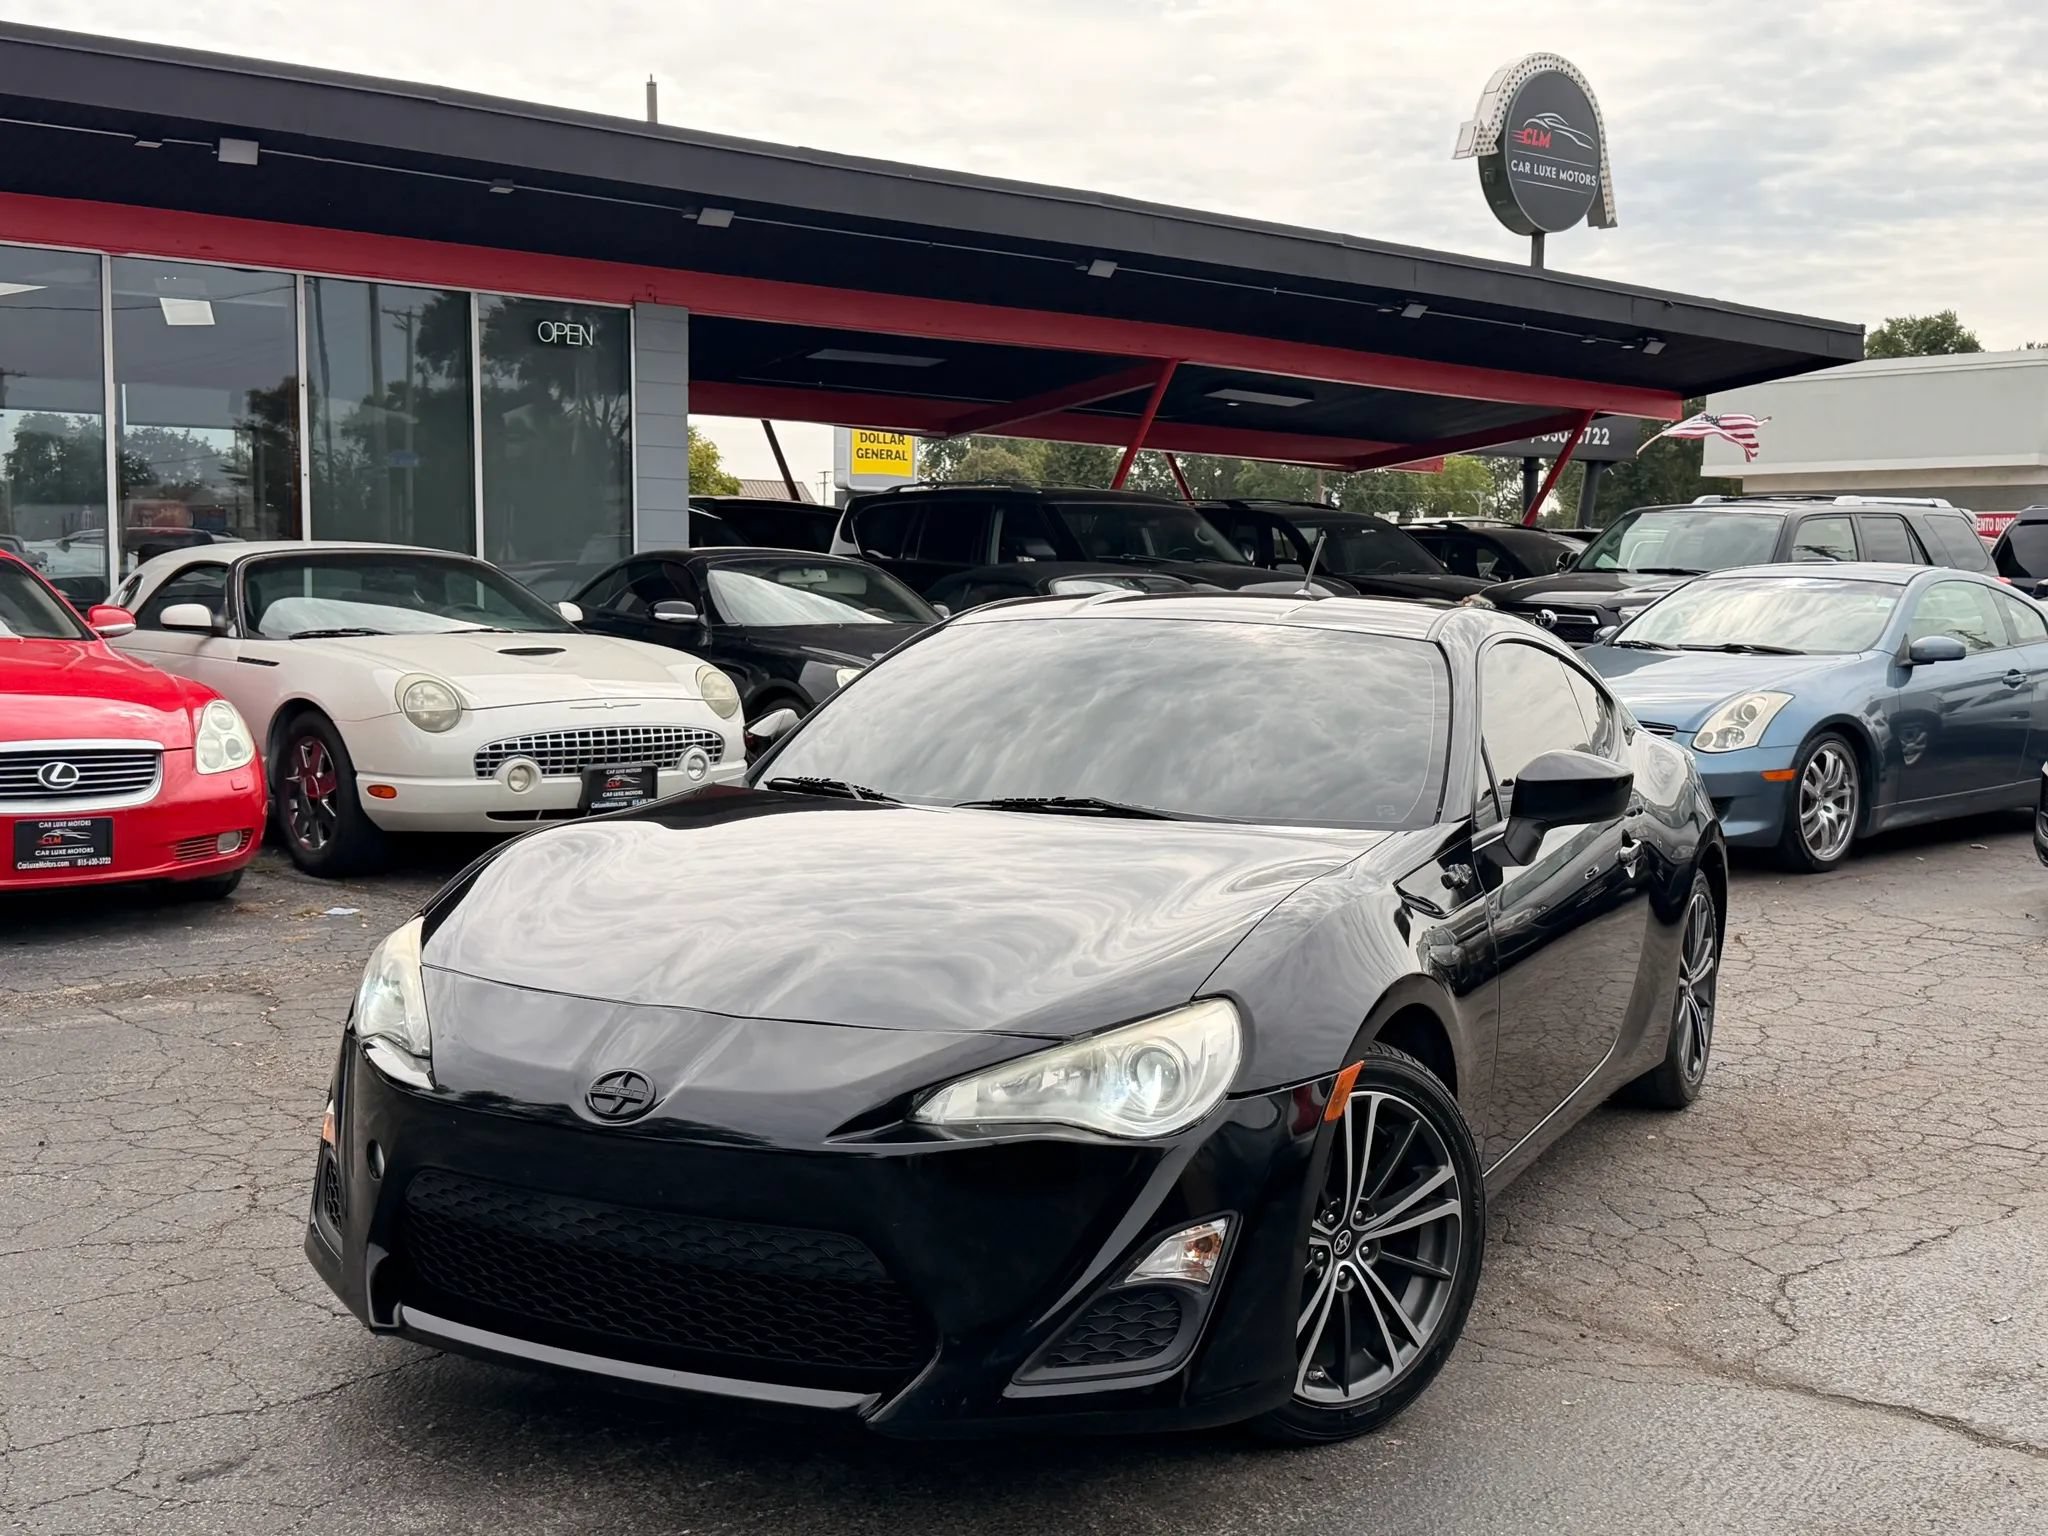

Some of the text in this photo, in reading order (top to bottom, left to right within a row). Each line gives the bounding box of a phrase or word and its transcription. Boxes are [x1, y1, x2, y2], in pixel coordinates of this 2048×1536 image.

[1522, 127, 1552, 148] CLM
[1511, 159, 1597, 187] CAR LUXE MOTORS
[537, 321, 594, 346] OPEN
[859, 431, 906, 446] DOLLAR
[856, 447, 908, 461] GENERAL
[38, 819, 92, 829] CAR LUXE MOTORS
[51, 848, 66, 856] LUXE
[67, 847, 95, 855] MOTORS
